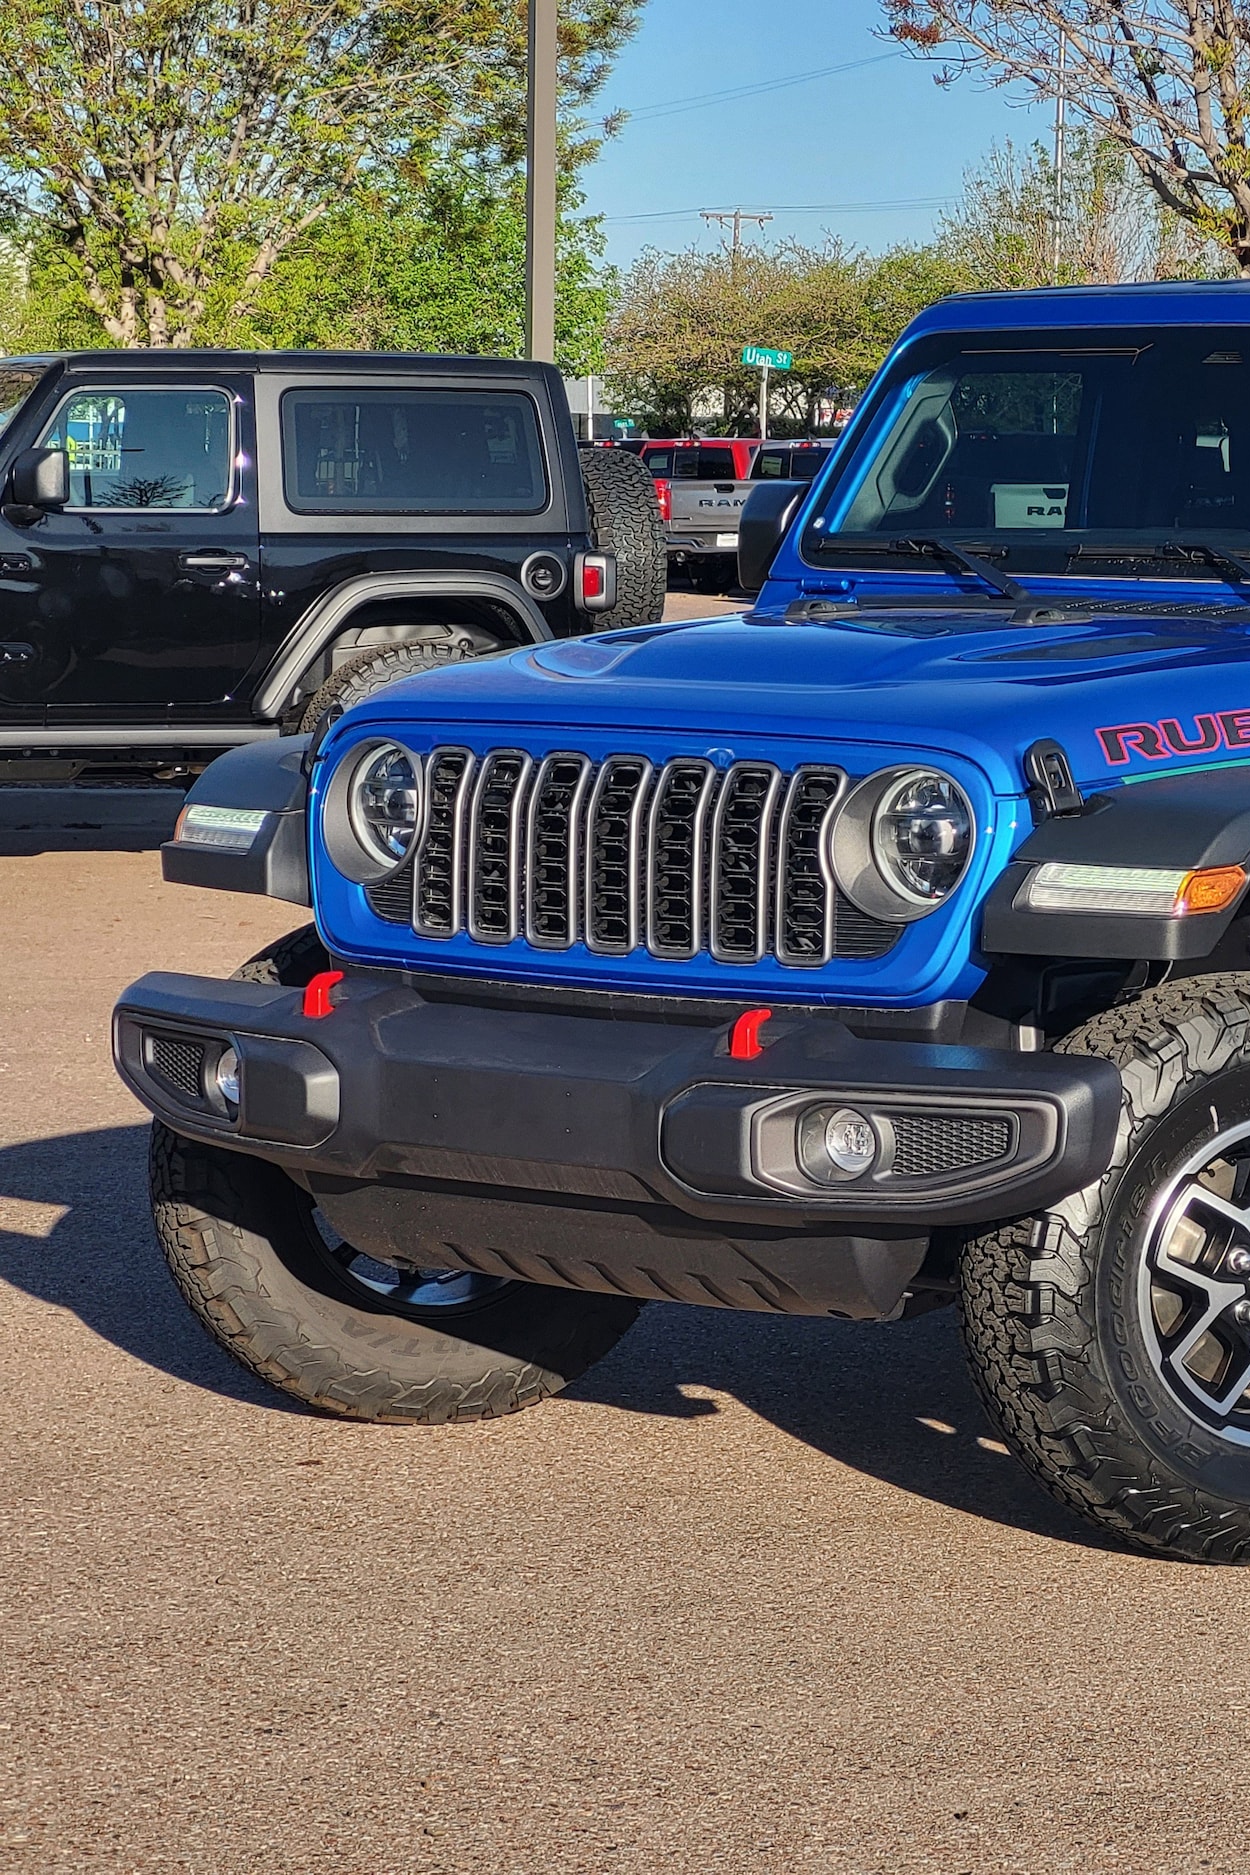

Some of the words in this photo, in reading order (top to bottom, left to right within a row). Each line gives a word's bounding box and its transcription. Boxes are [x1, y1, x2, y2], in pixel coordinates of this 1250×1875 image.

[746, 348, 772, 366] Utah
[776, 352, 788, 365] St
[1026, 506, 1063, 516] RA
